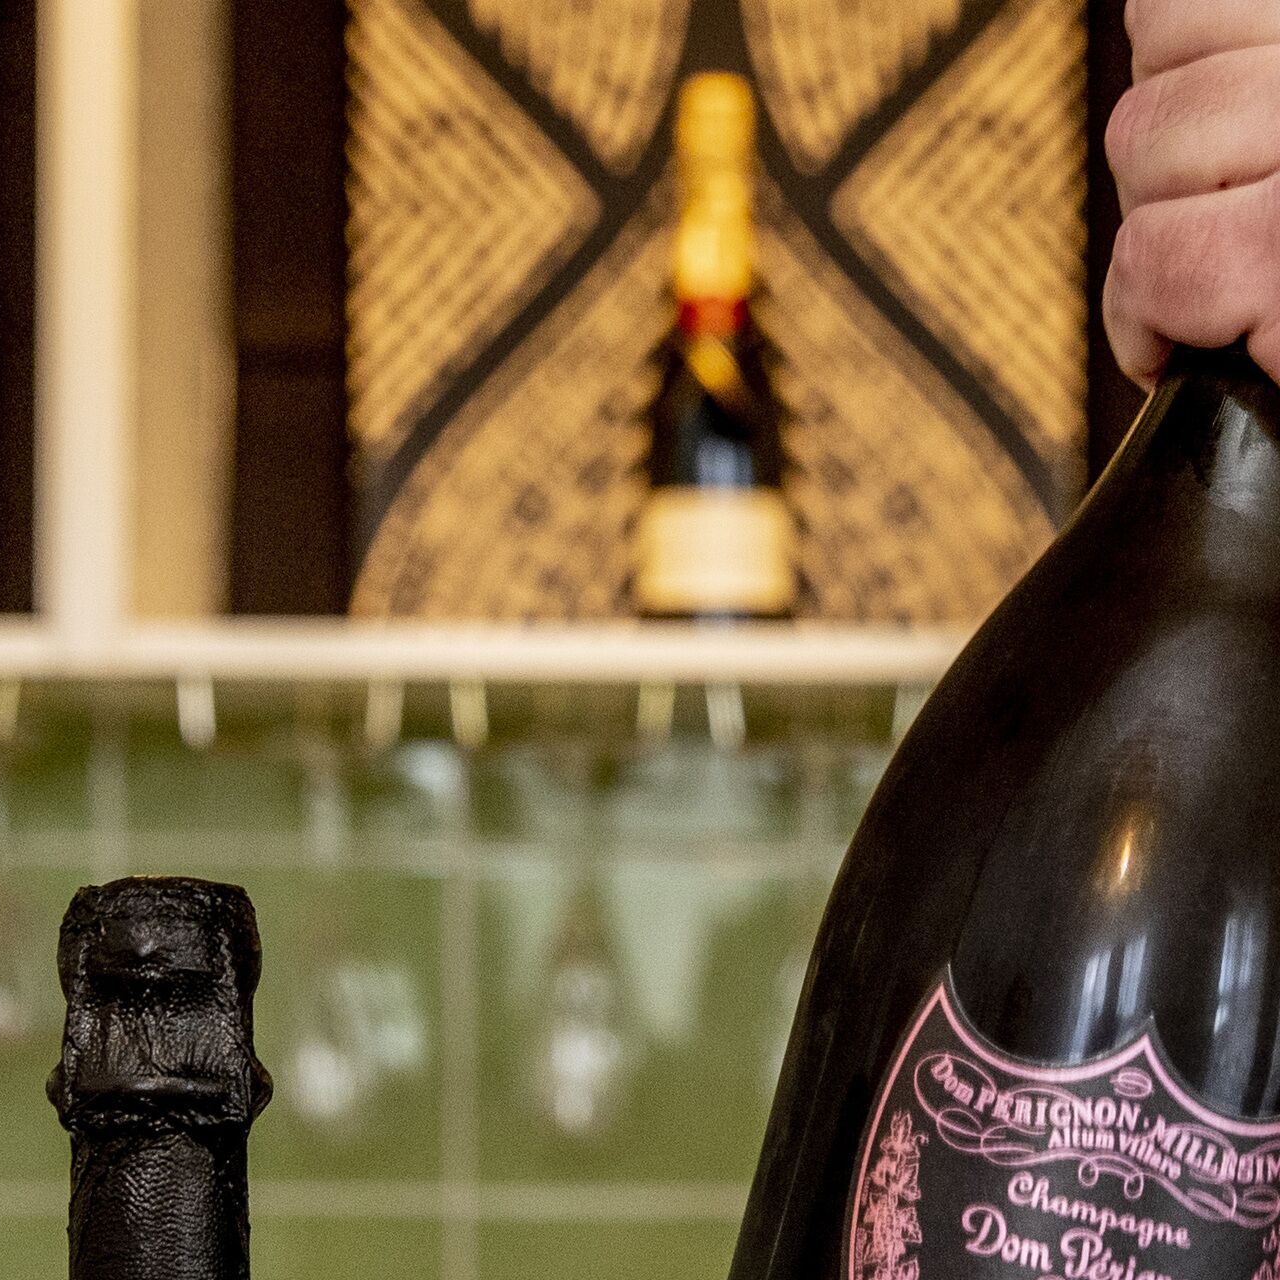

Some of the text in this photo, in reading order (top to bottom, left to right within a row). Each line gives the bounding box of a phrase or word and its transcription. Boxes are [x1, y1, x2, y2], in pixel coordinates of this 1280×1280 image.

[930, 1054, 974, 1106] Dom
[961, 1203, 1054, 1272] Dom
[1007, 1170, 1191, 1249] Champagne
